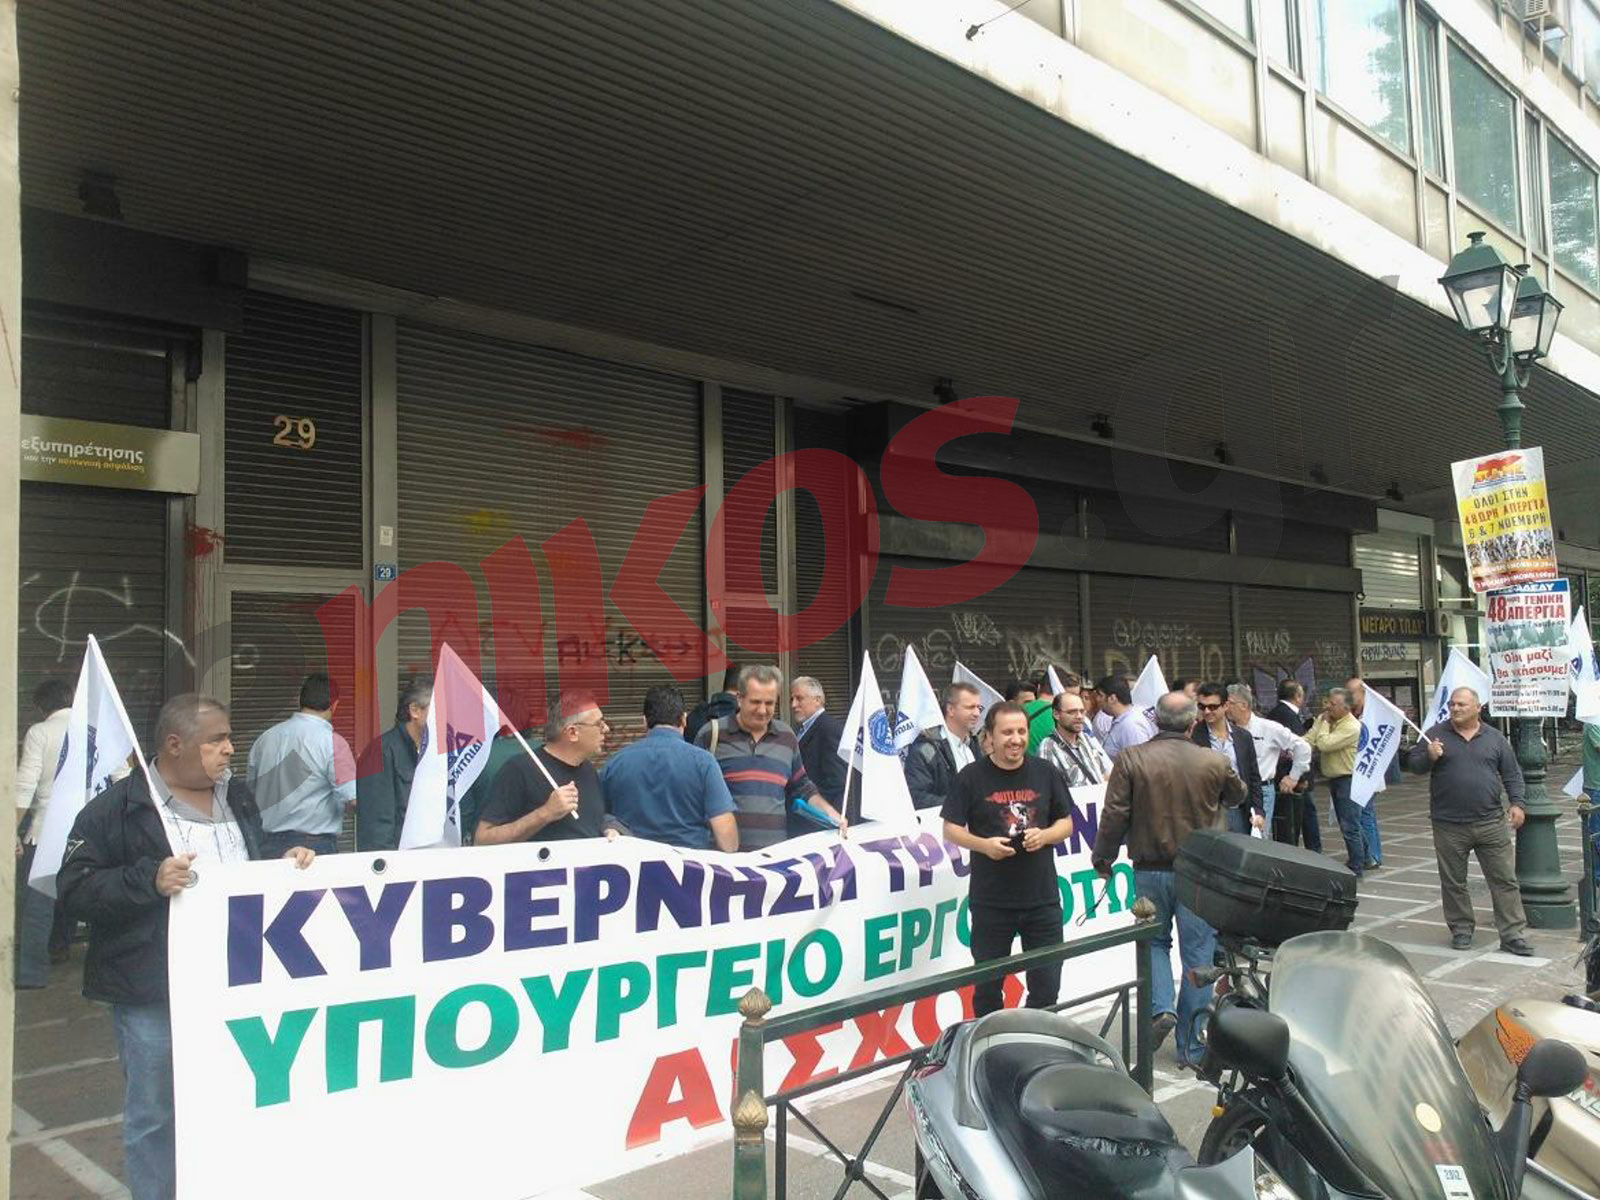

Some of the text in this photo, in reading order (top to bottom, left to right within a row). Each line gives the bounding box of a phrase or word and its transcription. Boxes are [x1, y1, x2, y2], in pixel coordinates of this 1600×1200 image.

[273, 415, 316, 449] 29
[21, 436, 144, 463] εξυπηρέτησης
[1464, 498, 1545, 525] 48ΩΡΗ ΑΠΕΡΓΙΑ
[1474, 487, 1528, 509] ΟΛΟΙ ΣΤΗΝ
[1469, 512, 1546, 539] 6 & 7 ΝΟΕΜΒΡΗ
[379, 567, 391, 578] 29
[1487, 596, 1507, 623] 48
[1524, 594, 1563, 605] ΓΕΝΙΚΗ
[1508, 605, 1565, 620] ΑΠΕΡΓΙΑ
[1360, 615, 1396, 634] ΜΕΓΑΡΟ
[1527, 648, 1553, 664] μαζί
[1496, 668, 1509, 678] θα
[227, 843, 858, 987] ΚΥΒΕΡΝΗΣΗ
[226, 929, 843, 1108] ΥΠΟΥΡΓΕΙΟ
